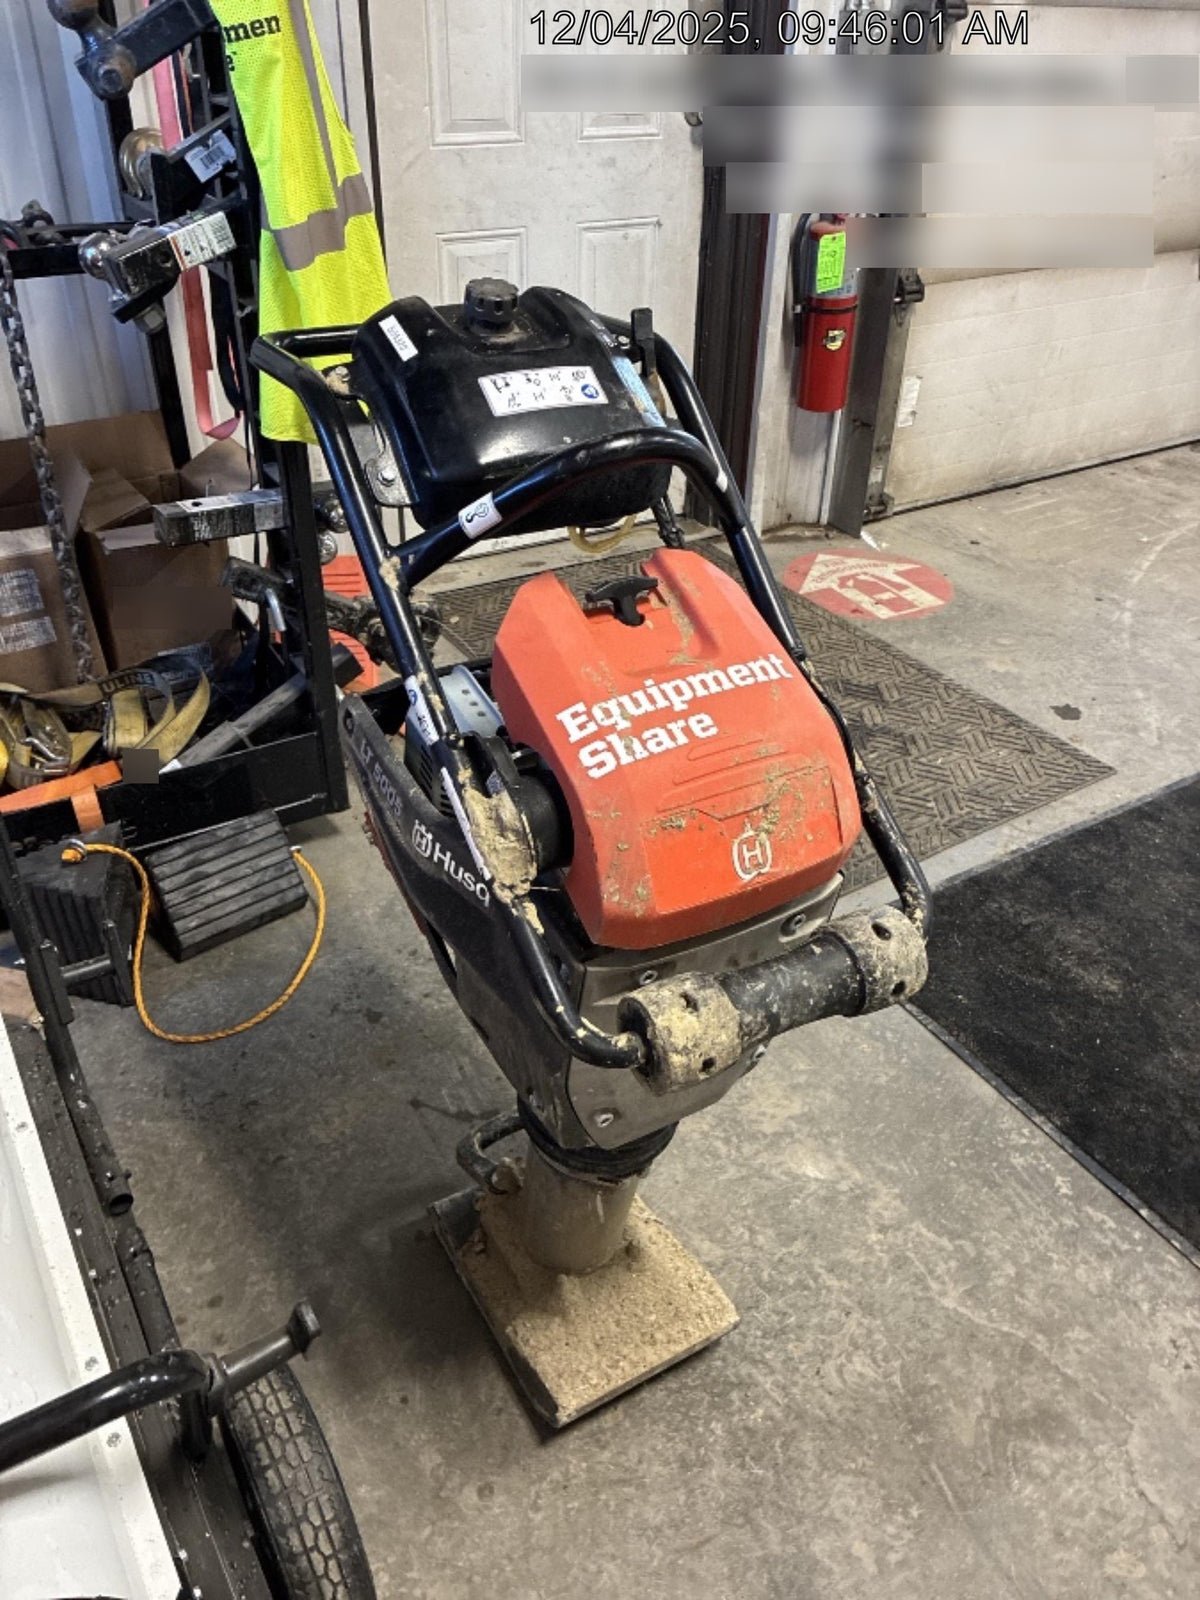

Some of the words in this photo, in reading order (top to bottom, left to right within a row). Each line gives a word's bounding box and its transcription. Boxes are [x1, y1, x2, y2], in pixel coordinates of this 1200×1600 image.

[101, 672, 154, 693] ULINE
[556, 653, 793, 743] Equipment
[578, 712, 719, 780] Share
